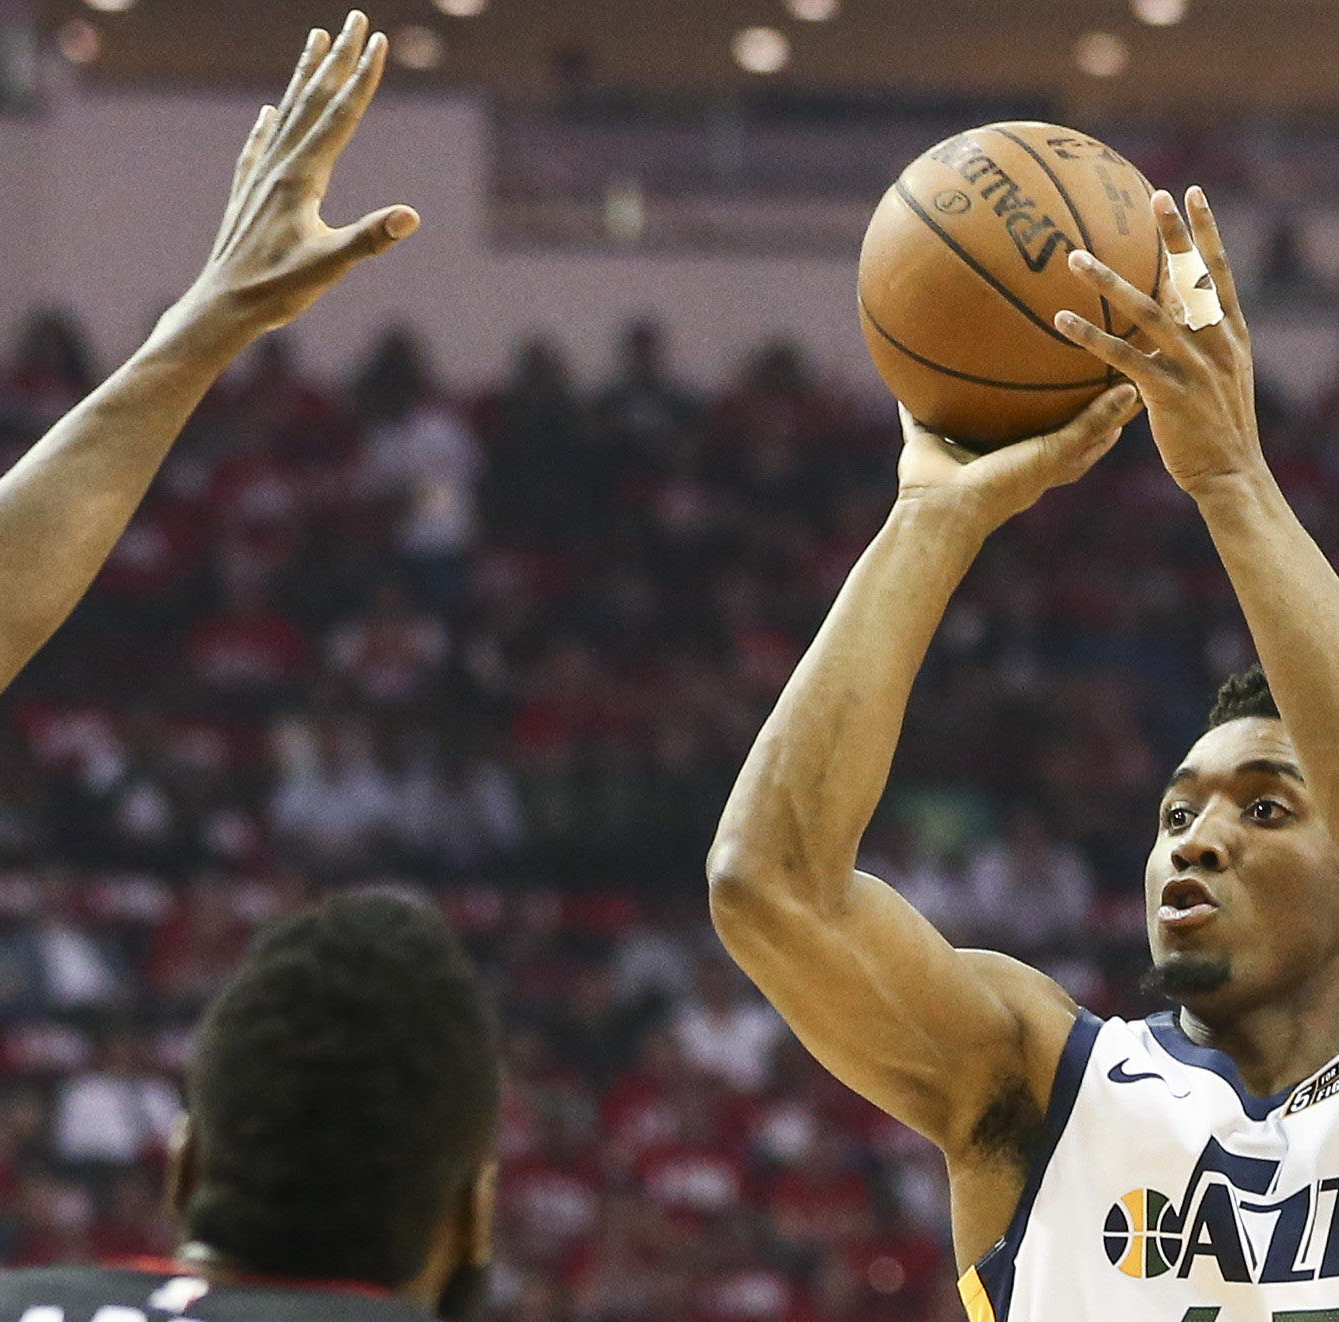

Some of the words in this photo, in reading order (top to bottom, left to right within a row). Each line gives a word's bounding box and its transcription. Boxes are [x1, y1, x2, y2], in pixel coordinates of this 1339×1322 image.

[930, 138, 1076, 272] SPALD
[1321, 1068, 1337, 1085] FOR
[1290, 1085, 1313, 1112] 5
